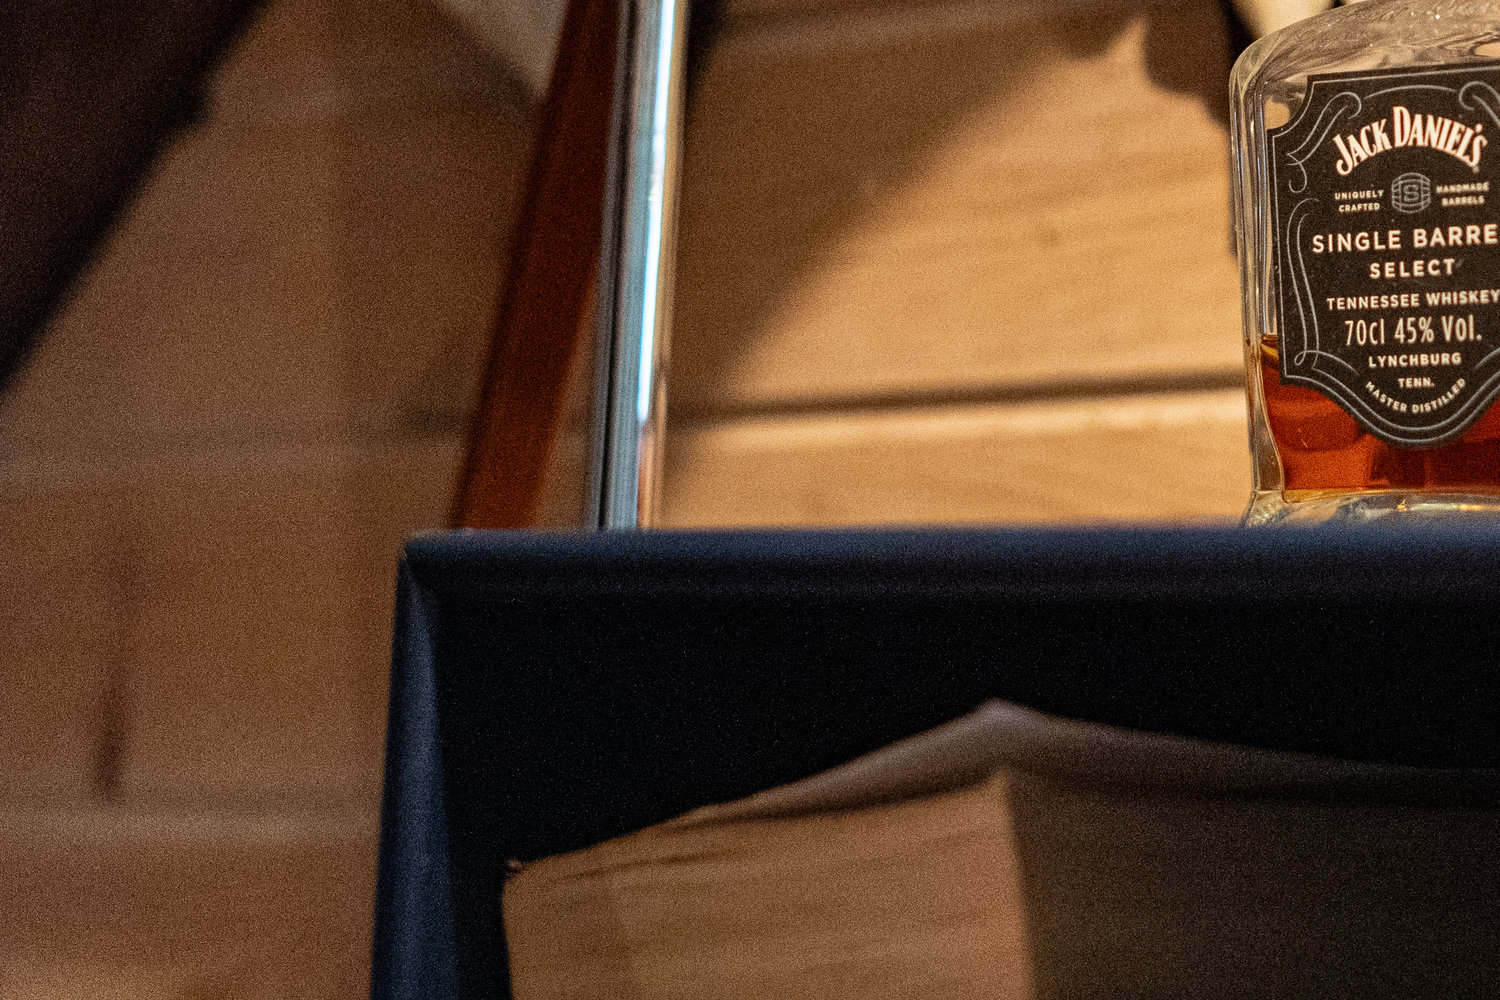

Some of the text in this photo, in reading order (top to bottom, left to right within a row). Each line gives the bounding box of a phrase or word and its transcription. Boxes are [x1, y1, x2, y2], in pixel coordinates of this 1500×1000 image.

[1332, 106, 1488, 176] JACK DANIEL'S
[1334, 188, 1385, 201] UNIQUELY
[1436, 181, 1490, 194] HANDMADE
[1338, 201, 1381, 213] CRAFTED
[1441, 194, 1486, 207] BARRELS
[1312, 229, 1402, 254] SINGLE
[1369, 258, 1456, 279] SELECT
[1326, 288, 1500, 310] TENNESSEE WHISKEY
[1344, 314, 1483, 346] 70cl 45% Vol.
[1368, 352, 1463, 369] LYNCHBURG
[1397, 377, 1435, 389] TENN.
[1364, 377, 1467, 414] MASTER DISTILLED
